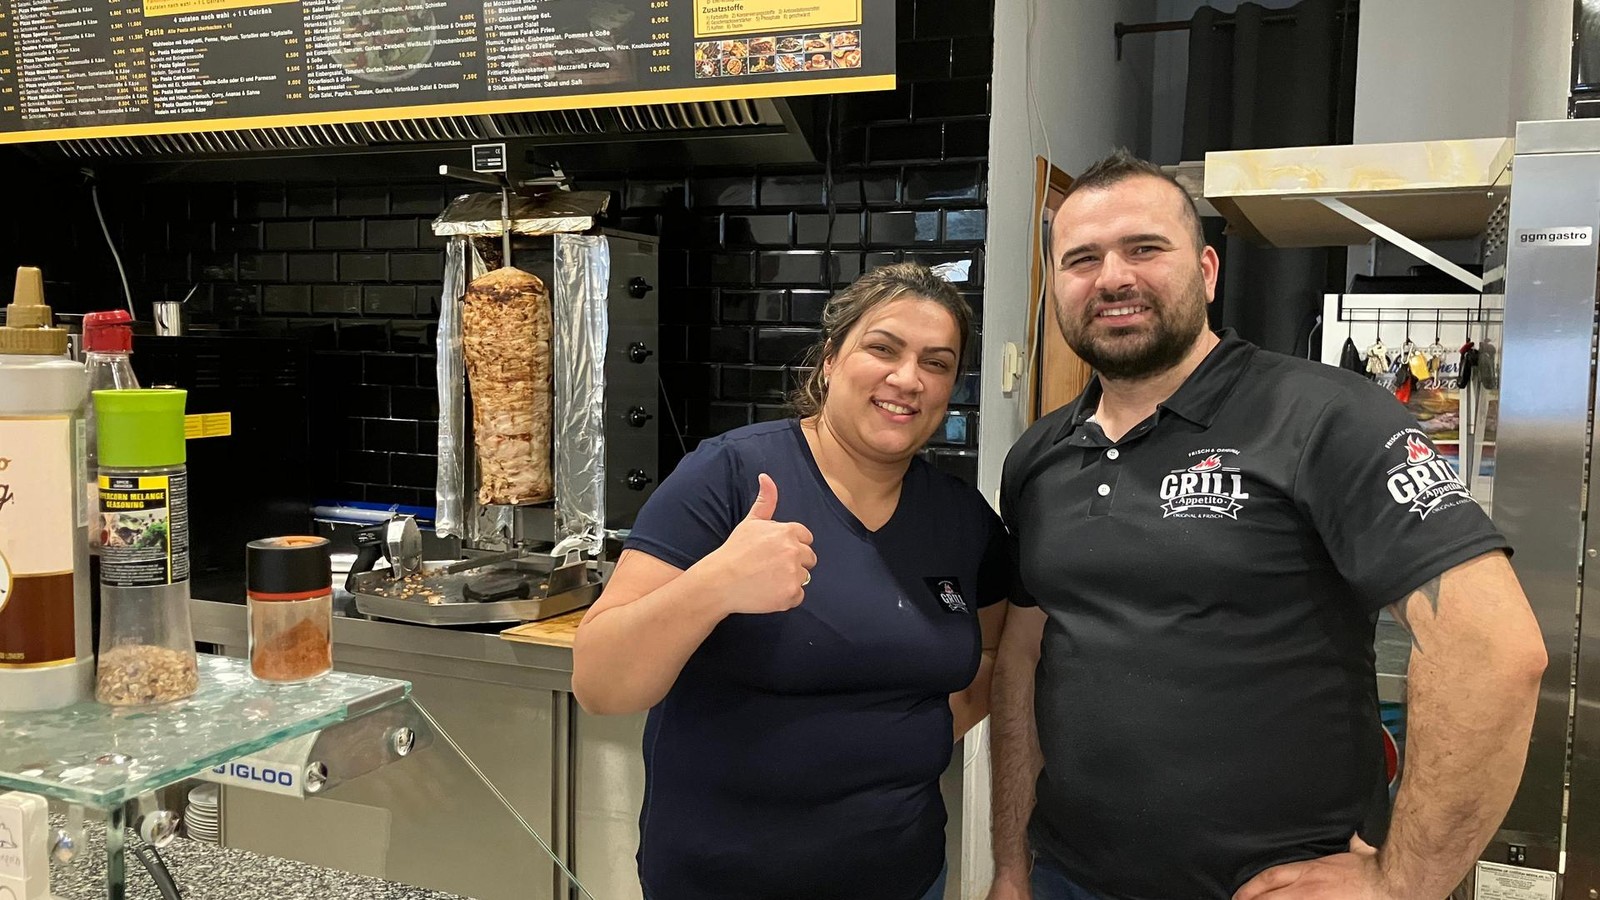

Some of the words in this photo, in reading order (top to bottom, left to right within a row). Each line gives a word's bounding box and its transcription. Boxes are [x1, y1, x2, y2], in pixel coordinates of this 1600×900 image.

[498, 5, 537, 13] Bratkartoffeln
[702, 4, 743, 13] Zusatzstoffe
[1160, 473, 1249, 500] GRILL
[130, 492, 164, 500] MELANGE
[1179, 496, 1224, 505] Appetito
[230, 763, 292, 786] IGLOO
